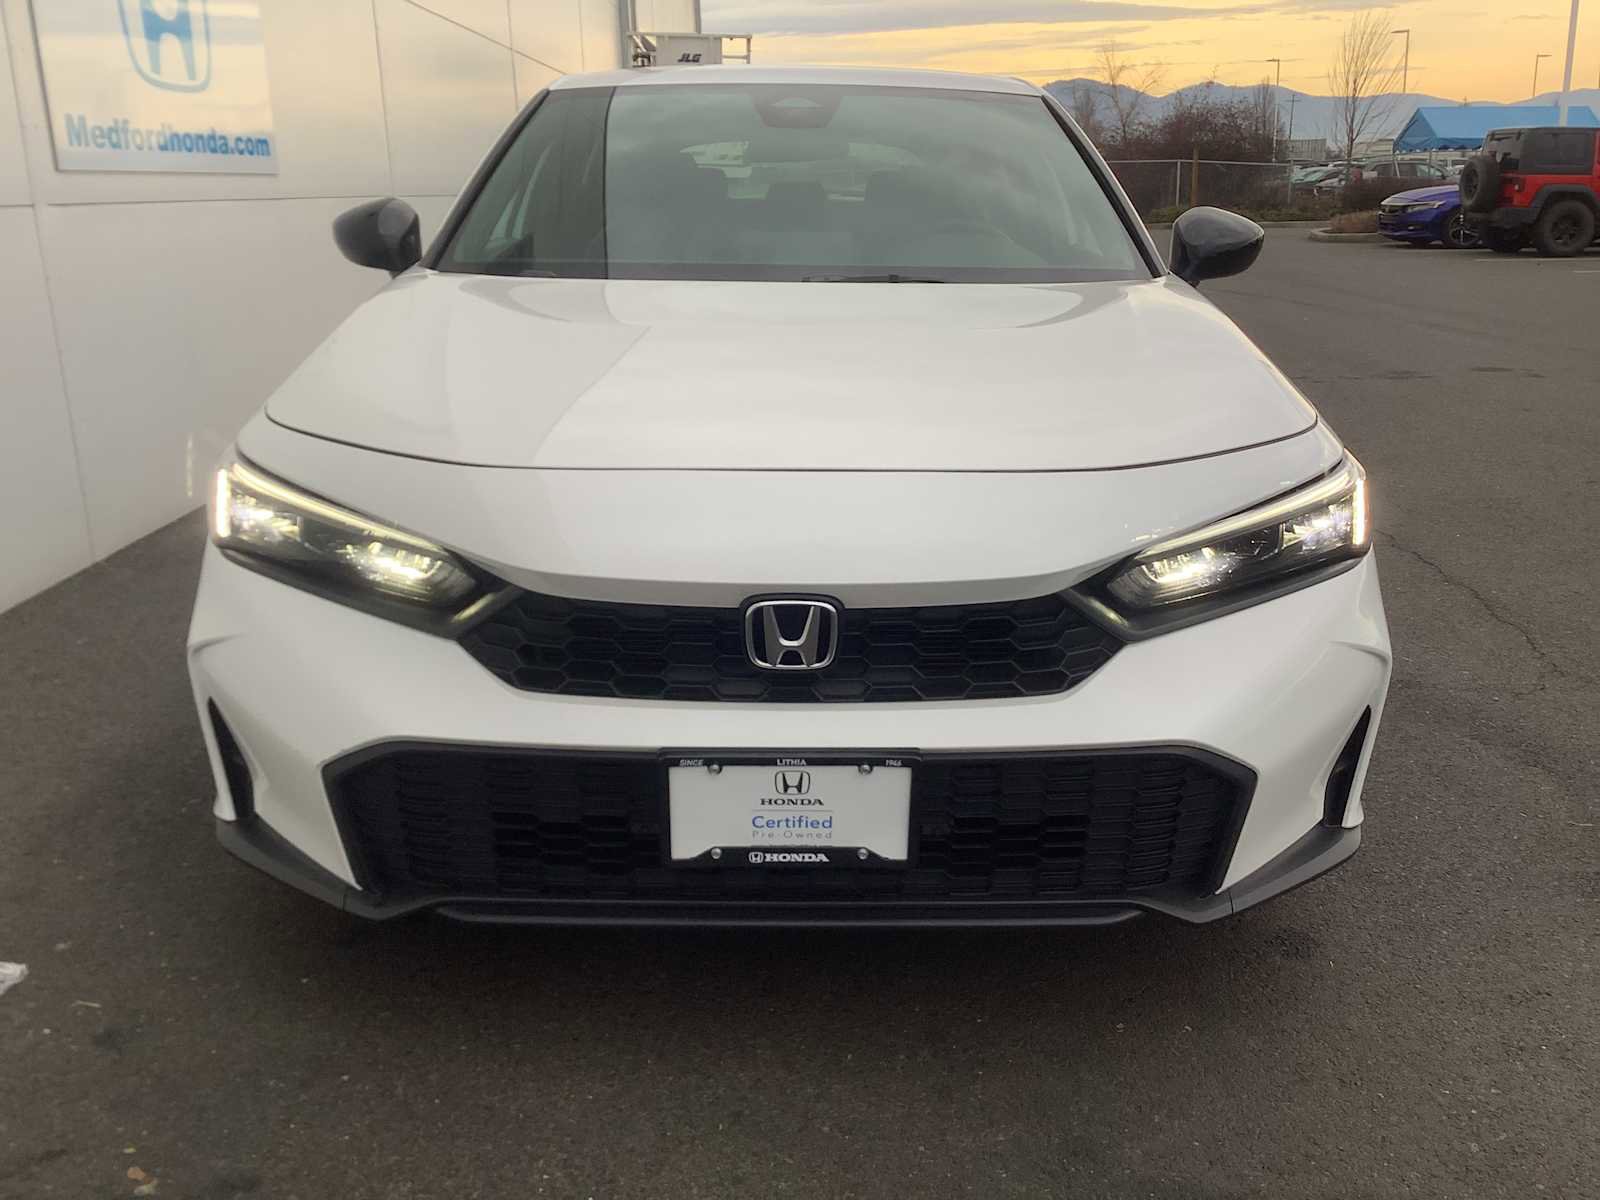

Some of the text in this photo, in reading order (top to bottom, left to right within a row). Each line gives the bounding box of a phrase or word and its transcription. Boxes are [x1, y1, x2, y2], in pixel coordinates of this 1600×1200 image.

[678, 53, 702, 63] JLG
[777, 758, 807, 766] LITHIA
[760, 798, 824, 806] HONDA
[752, 816, 832, 828] Certified
[764, 853, 830, 862] HONDA
